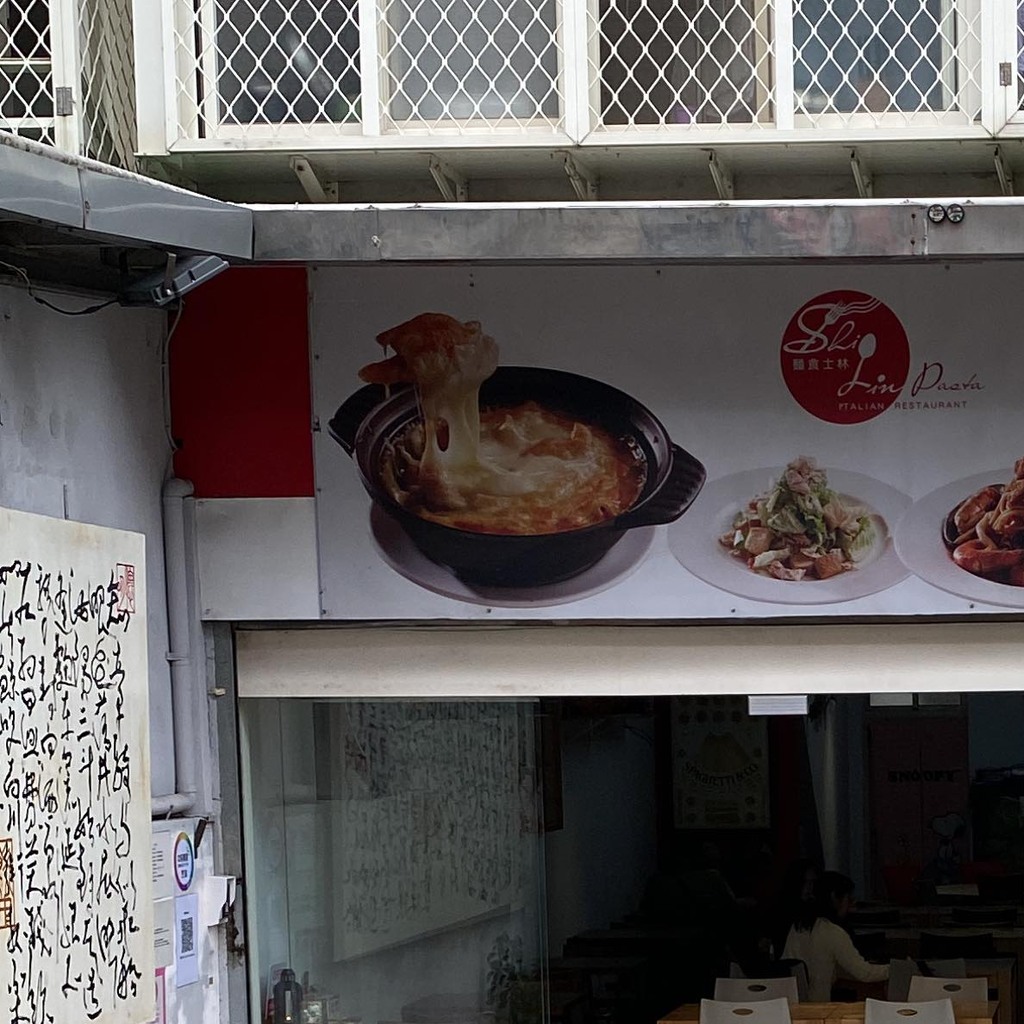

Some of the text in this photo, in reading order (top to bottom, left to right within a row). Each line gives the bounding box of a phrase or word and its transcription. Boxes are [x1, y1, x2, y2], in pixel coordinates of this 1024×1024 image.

[837, 332, 985, 397] Lin Pasta
[838, 400, 968, 411] ITALIAN RESTAURANT
